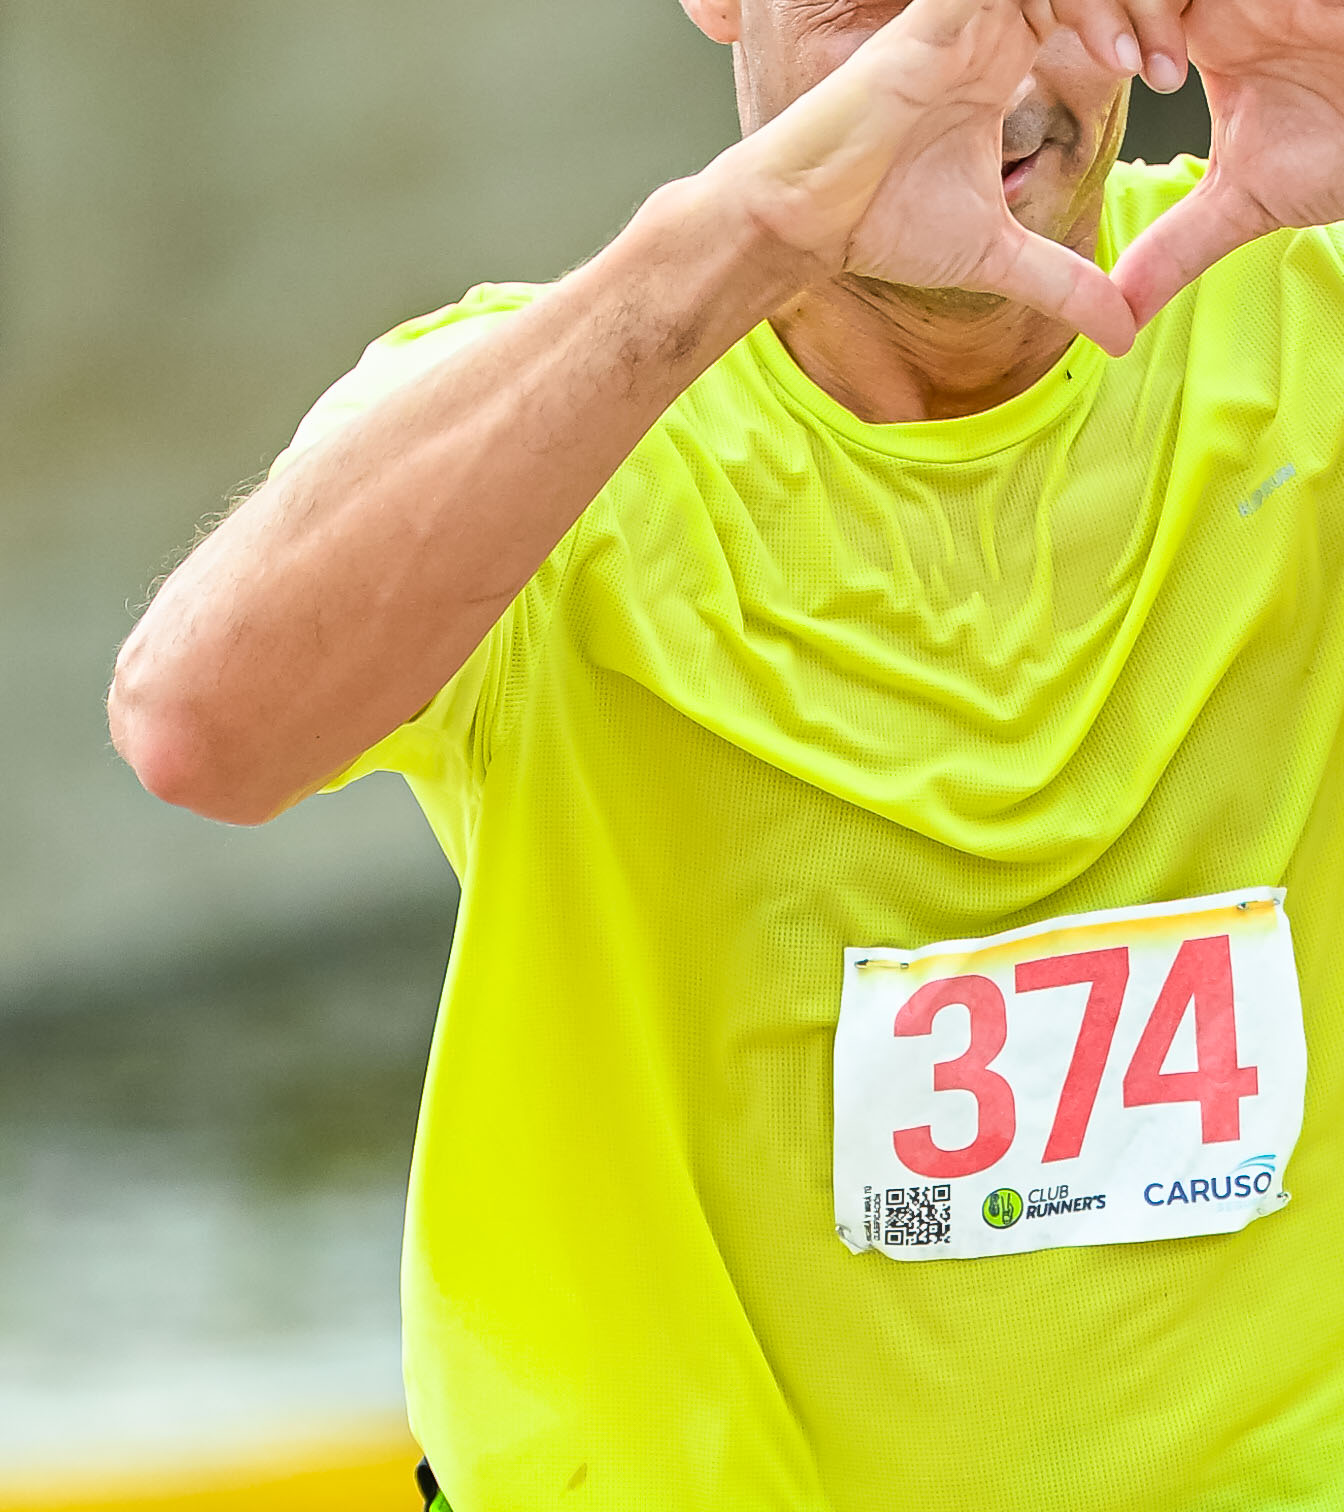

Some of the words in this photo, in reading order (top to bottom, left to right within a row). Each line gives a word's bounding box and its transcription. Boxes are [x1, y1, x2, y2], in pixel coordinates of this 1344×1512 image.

[893, 934, 1258, 1179] 374
[1027, 1185, 1069, 1204] CLUB
[1143, 1172, 1272, 1206] CARUSO
[1026, 1194, 1106, 1219] RUNNER'S
